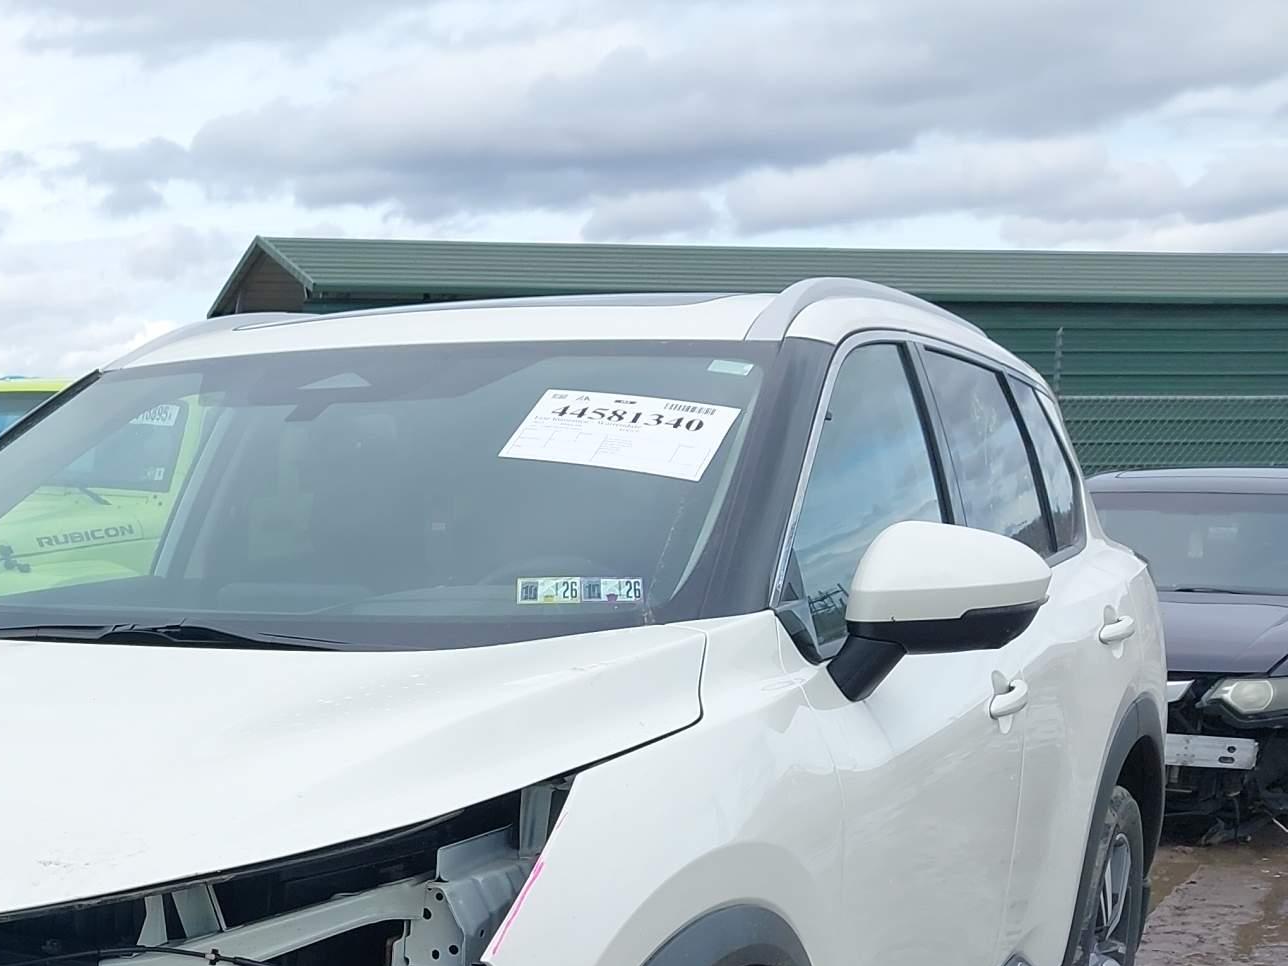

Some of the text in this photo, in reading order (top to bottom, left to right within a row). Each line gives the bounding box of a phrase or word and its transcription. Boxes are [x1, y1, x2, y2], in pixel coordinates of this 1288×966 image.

[551, 404, 705, 432] 44581340
[35, 524, 134, 547] RUBICON
[562, 581, 578, 599] 26
[625, 580, 641, 599] 26
